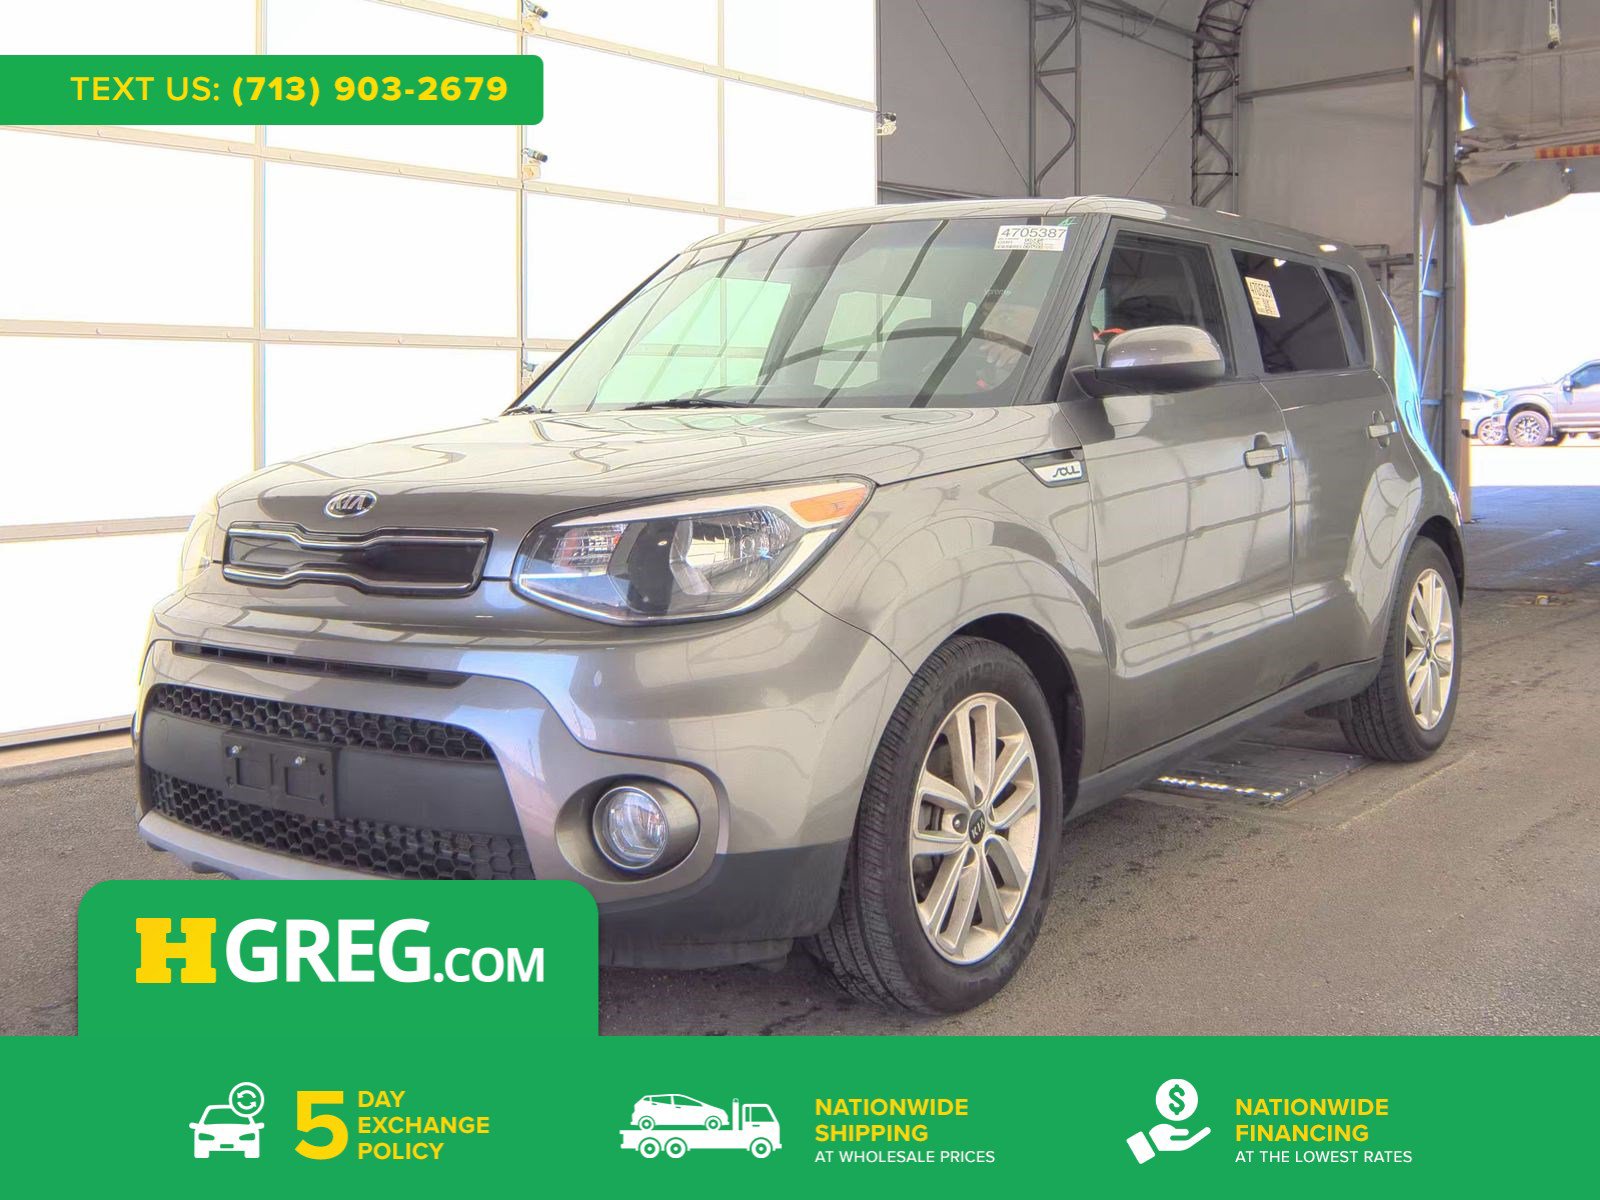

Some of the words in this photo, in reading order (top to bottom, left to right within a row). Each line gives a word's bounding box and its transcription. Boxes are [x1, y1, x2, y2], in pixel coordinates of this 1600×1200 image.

[1000, 227, 1066, 238] 4705387
[329, 494, 368, 511] KIA
[971, 816, 985, 839] KIA
